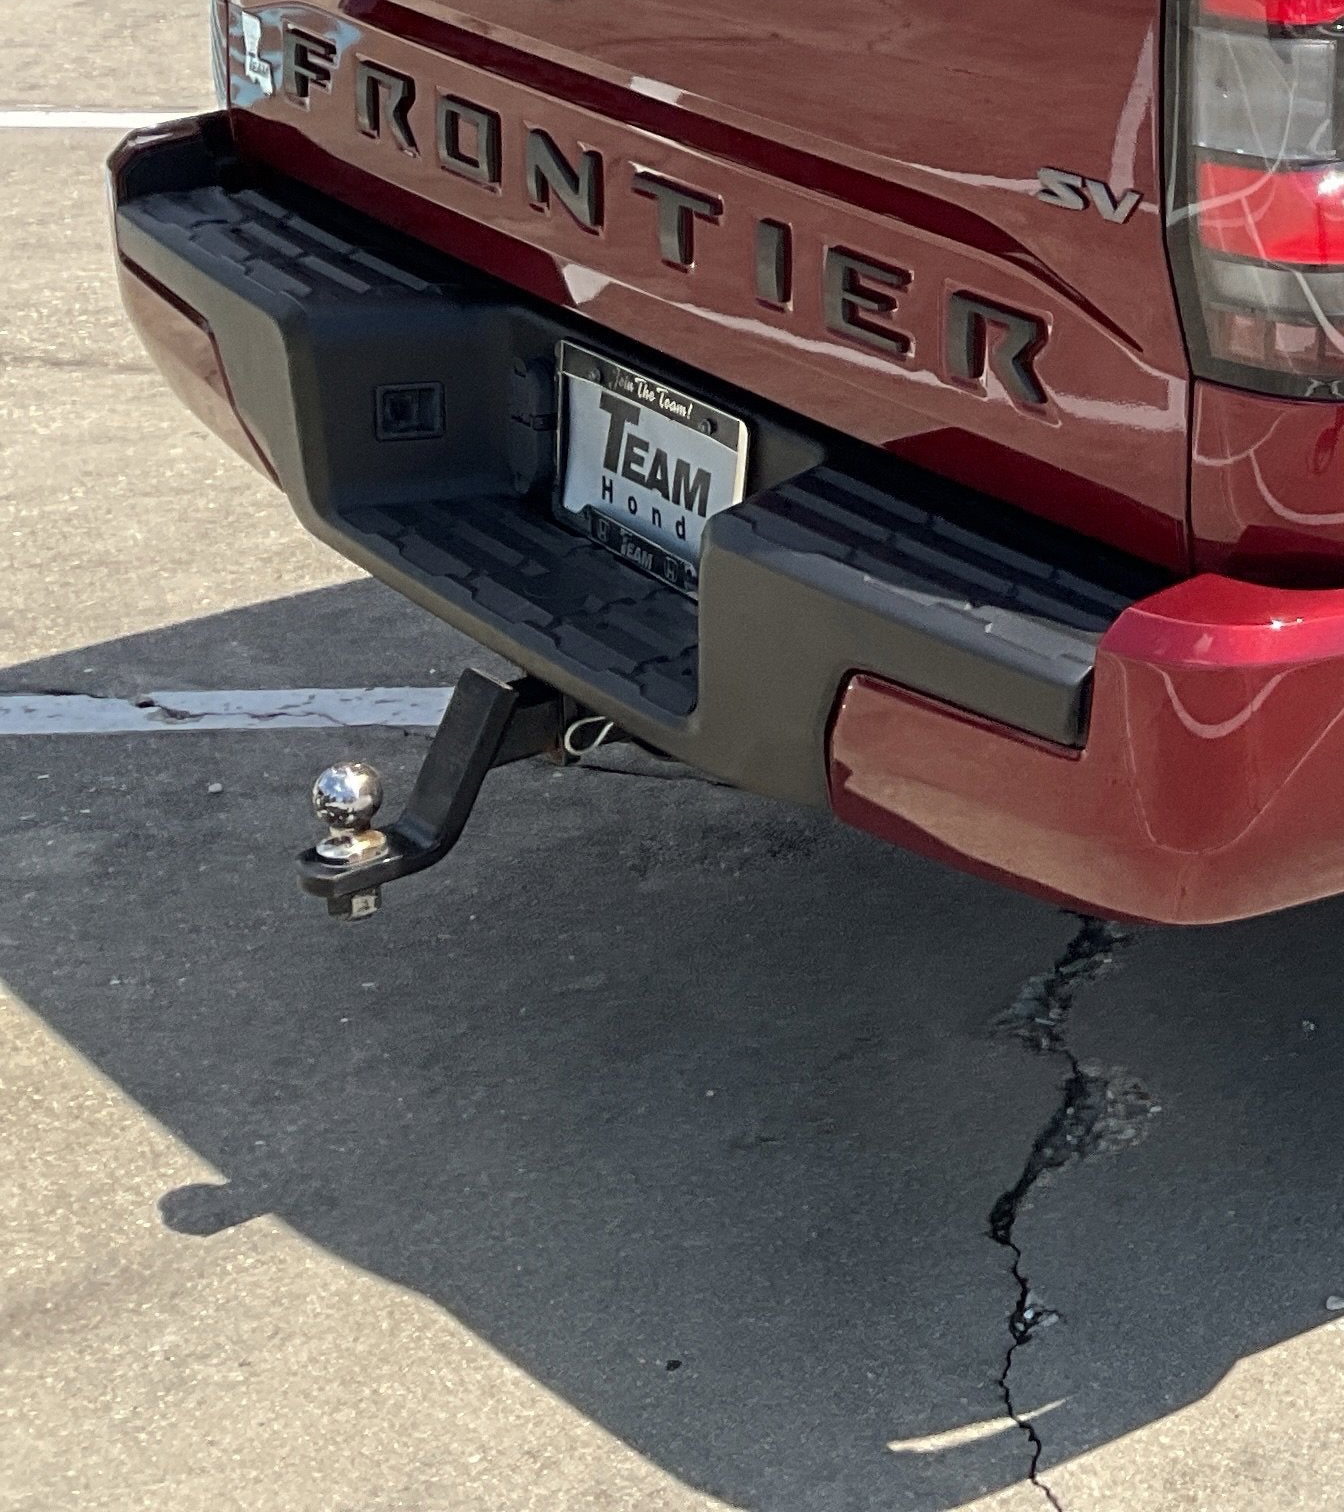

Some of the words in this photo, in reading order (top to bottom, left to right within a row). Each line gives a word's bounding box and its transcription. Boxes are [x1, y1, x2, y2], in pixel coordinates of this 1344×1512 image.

[281, 22, 1052, 413] FRONTIER
[1036, 167, 1143, 225] SV
[634, 377, 656, 402] The
[656, 387, 693, 420] Team!
[599, 391, 712, 518] TEAM
[601, 475, 687, 541] Hond
[620, 527, 653, 570] TEAM
